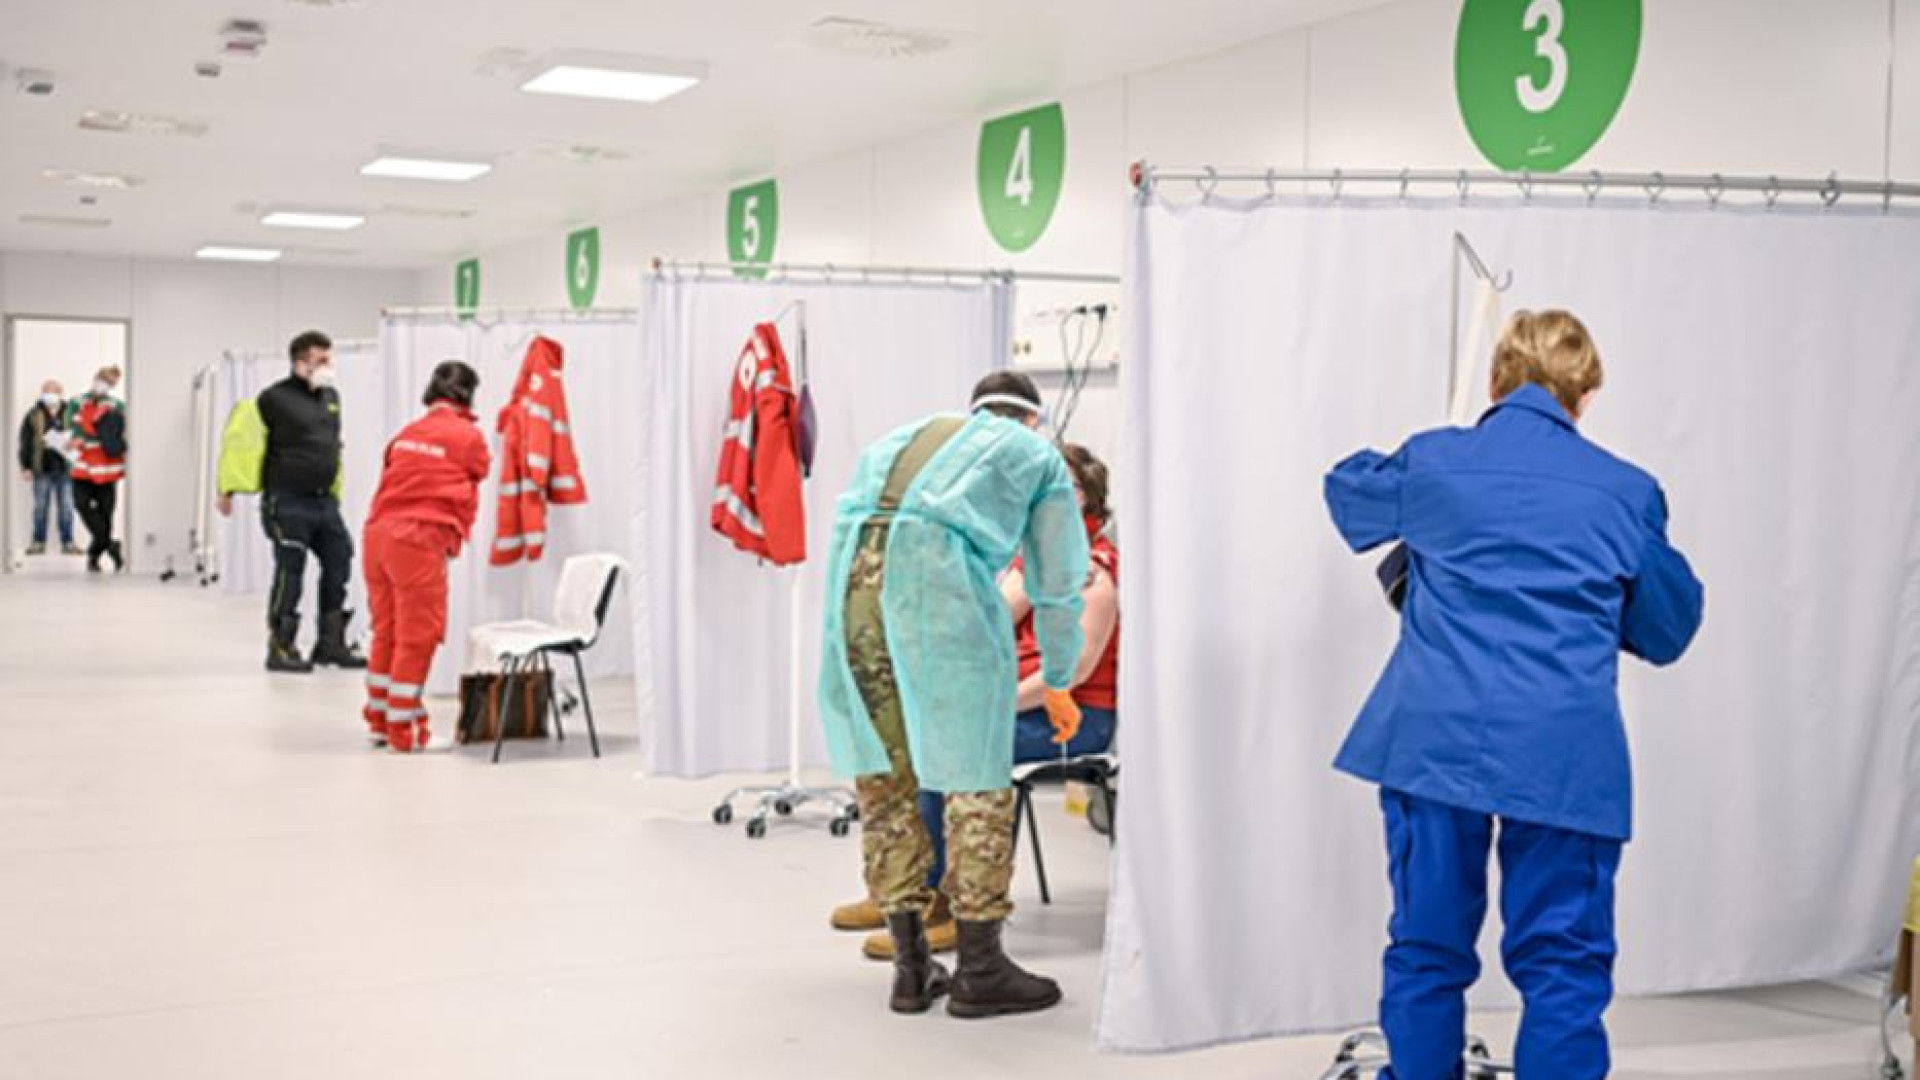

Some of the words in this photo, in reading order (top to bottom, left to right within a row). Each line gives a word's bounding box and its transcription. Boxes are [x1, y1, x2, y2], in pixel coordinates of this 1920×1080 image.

[1515, 0, 1568, 113] 3
[1005, 126, 1033, 206] 4
[742, 196, 760, 258] 5
[575, 239, 589, 290] 6
